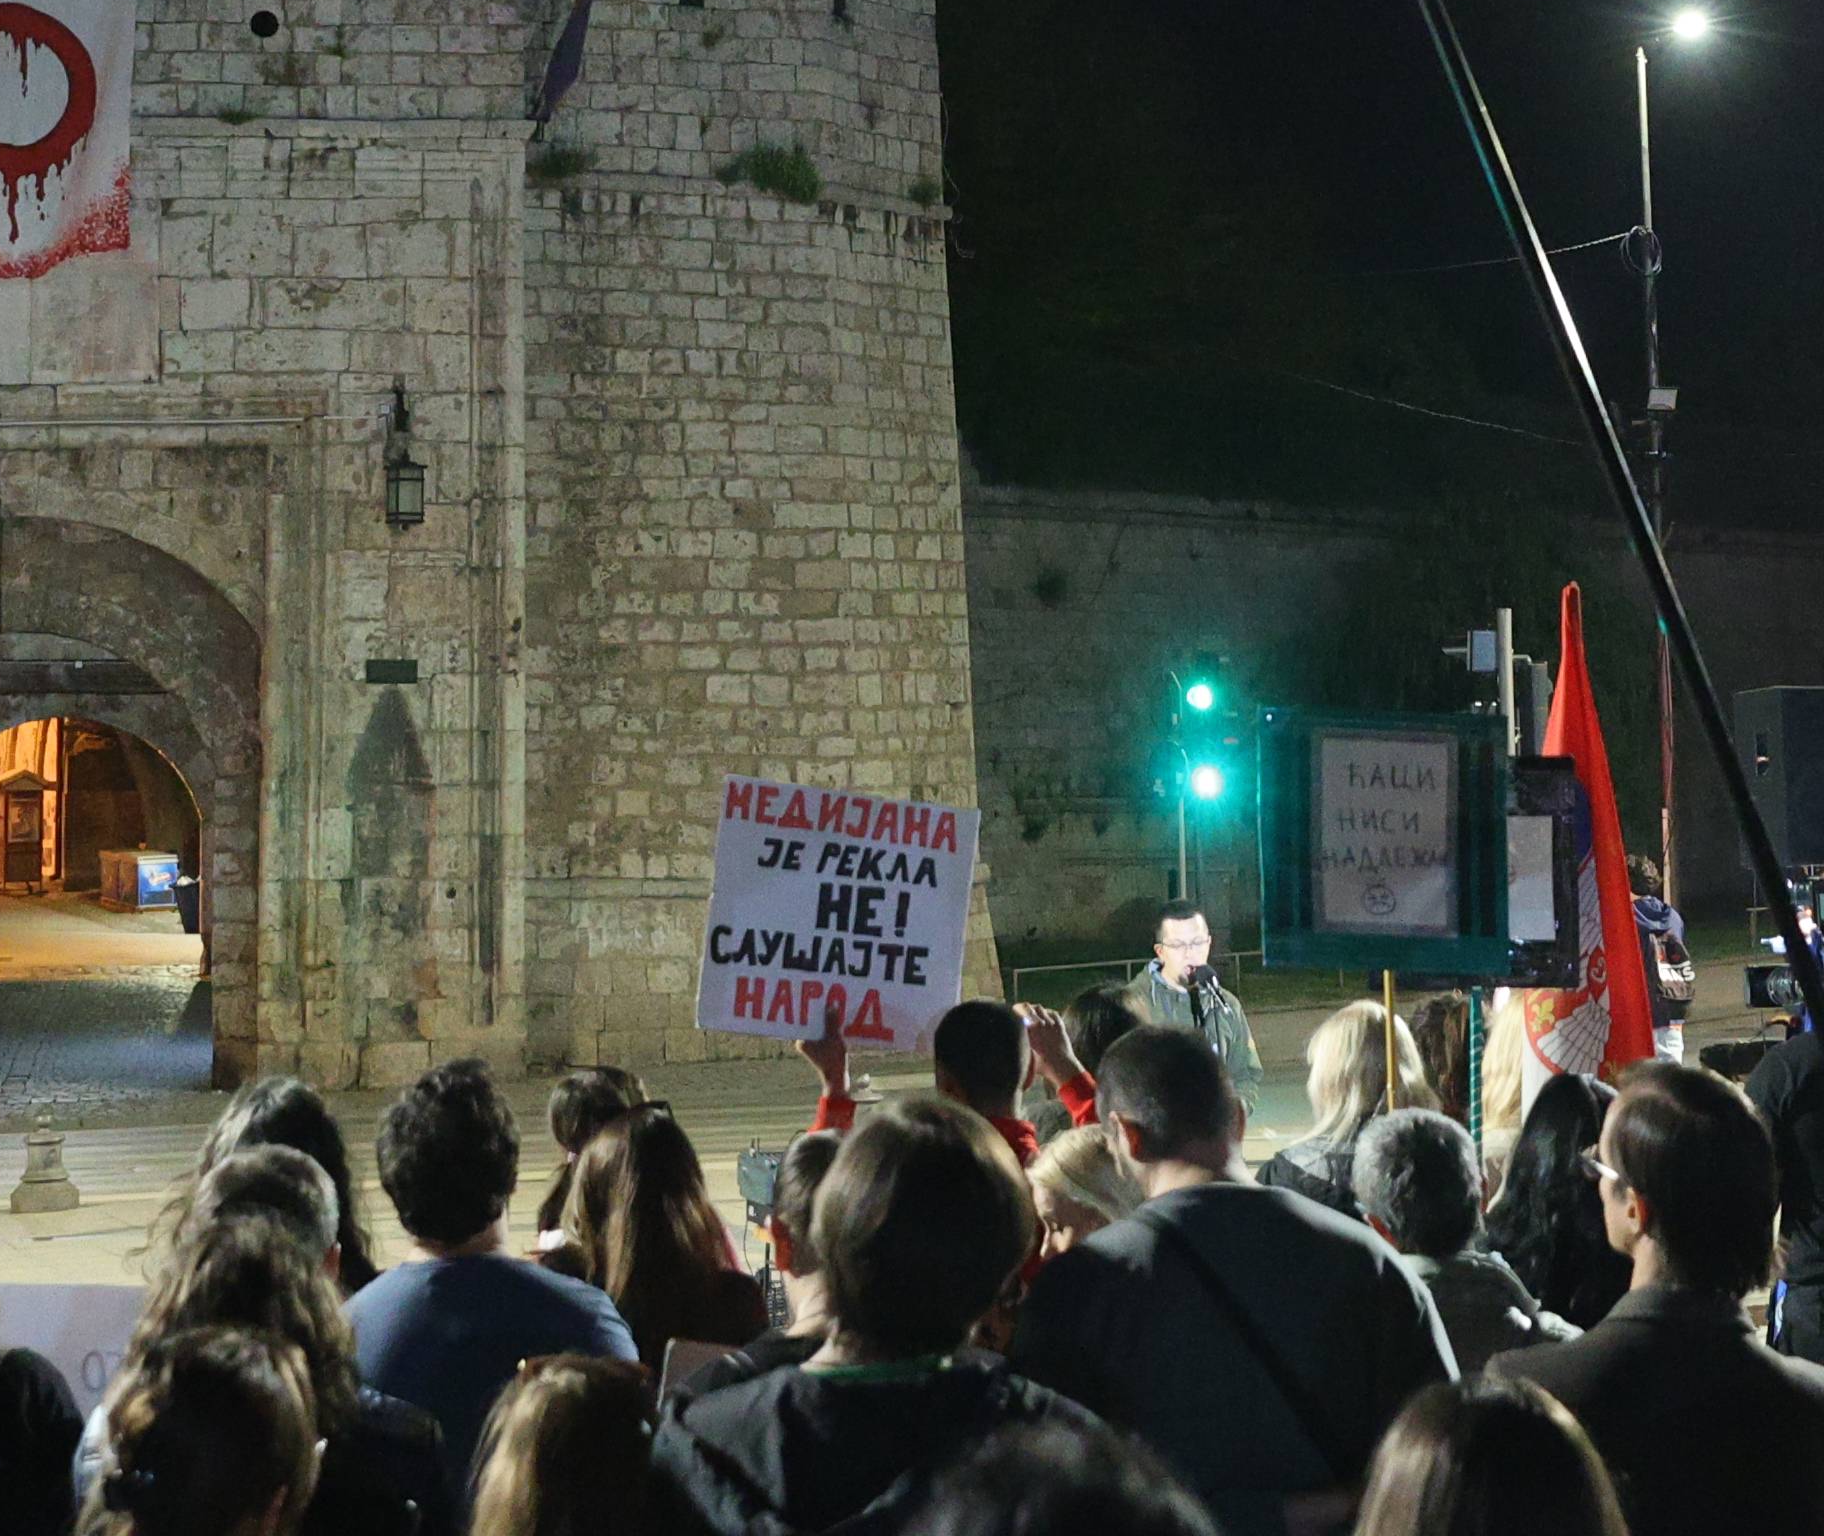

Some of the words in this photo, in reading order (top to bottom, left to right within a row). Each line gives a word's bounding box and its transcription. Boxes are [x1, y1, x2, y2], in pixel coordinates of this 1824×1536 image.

[726, 781, 957, 853] МЕДИЈАНА
[1337, 808, 1419, 834] НИСИ
[758, 838, 805, 870] ЈЕ
[816, 842, 937, 887] РЕКЛА
[815, 883, 911, 937] НЕ!
[710, 925, 929, 986] СЛУШАЈТЕ
[734, 976, 894, 1042] НАРОД
